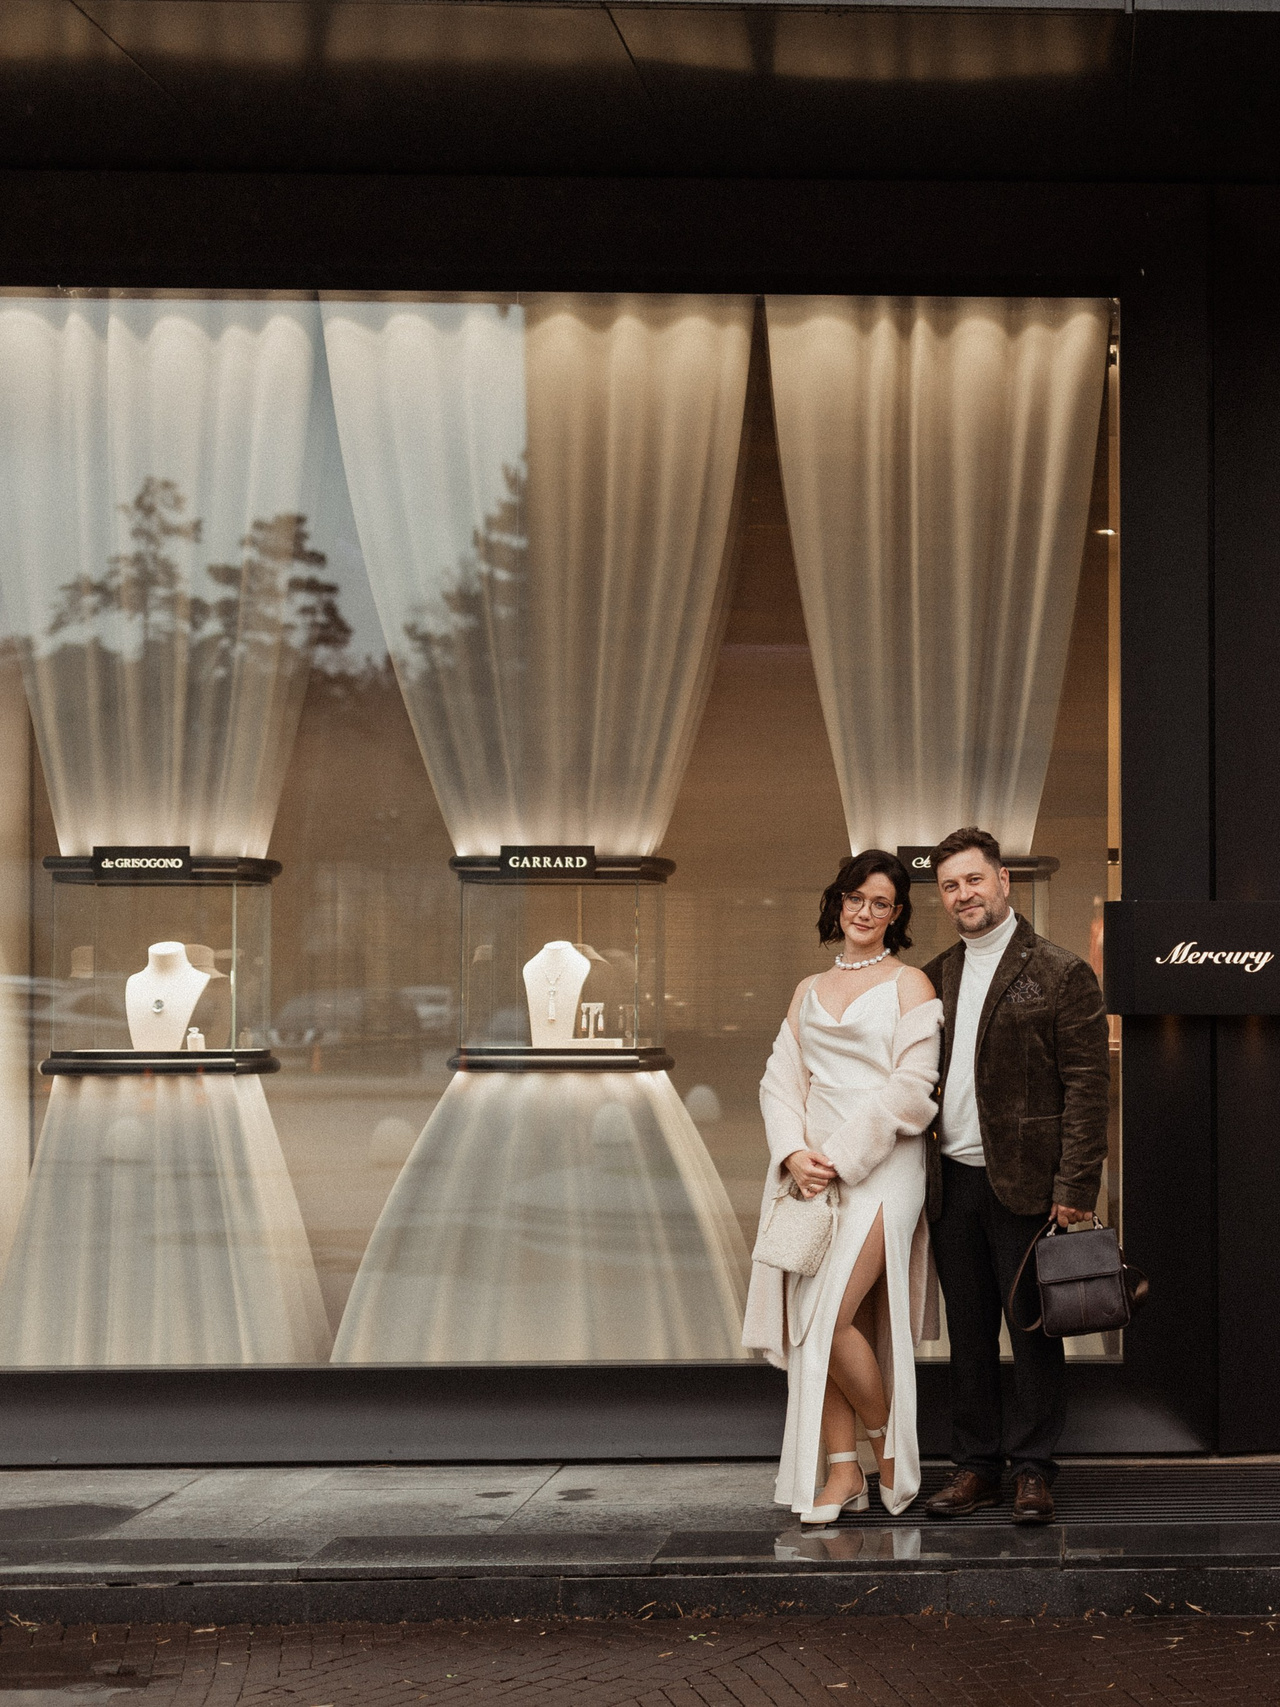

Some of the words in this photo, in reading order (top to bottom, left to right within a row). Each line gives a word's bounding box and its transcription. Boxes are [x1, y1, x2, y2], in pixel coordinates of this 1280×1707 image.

[101, 858, 114, 869] de
[115, 858, 183, 869] GRISOGONO
[508, 856, 588, 868] GARRARD
[1155, 941, 1275, 973] Mercury
